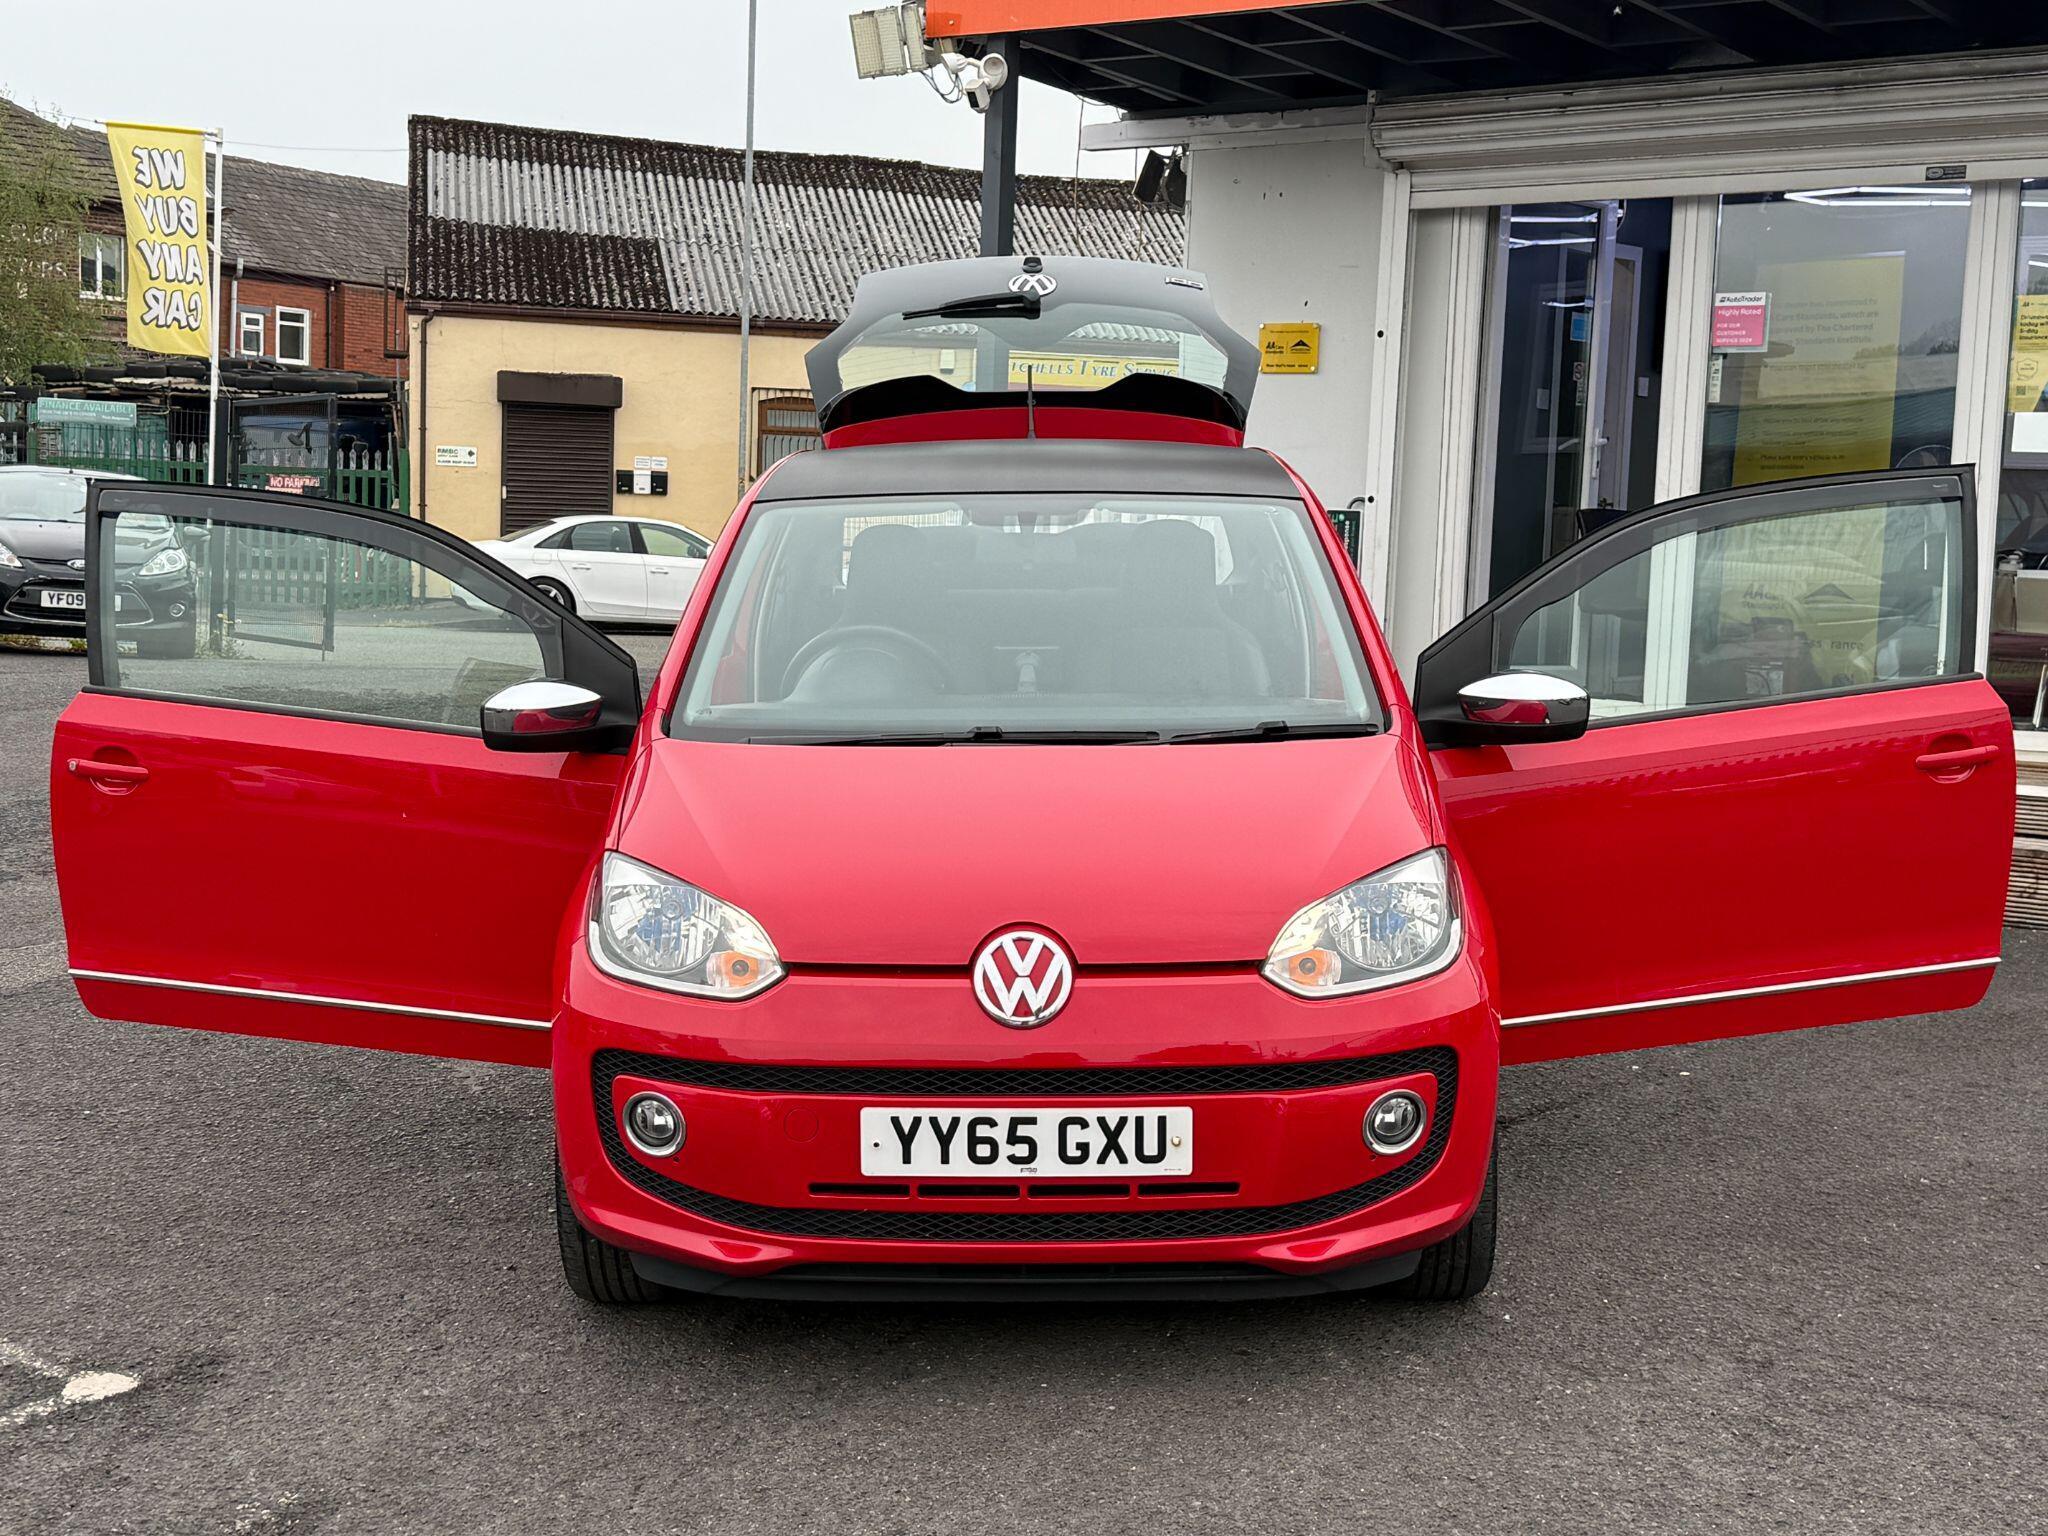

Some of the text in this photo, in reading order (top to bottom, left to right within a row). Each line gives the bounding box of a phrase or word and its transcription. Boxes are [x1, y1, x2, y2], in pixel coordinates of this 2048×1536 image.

[1718, 308, 1762, 316] Highly Rated
[40, 400, 82, 411] FINANCE
[270, 476, 283, 488] NO
[47, 592, 85, 607] YF09
[974, 930, 1073, 1029] VW
[890, 1115, 1168, 1165] YY65 GXU
